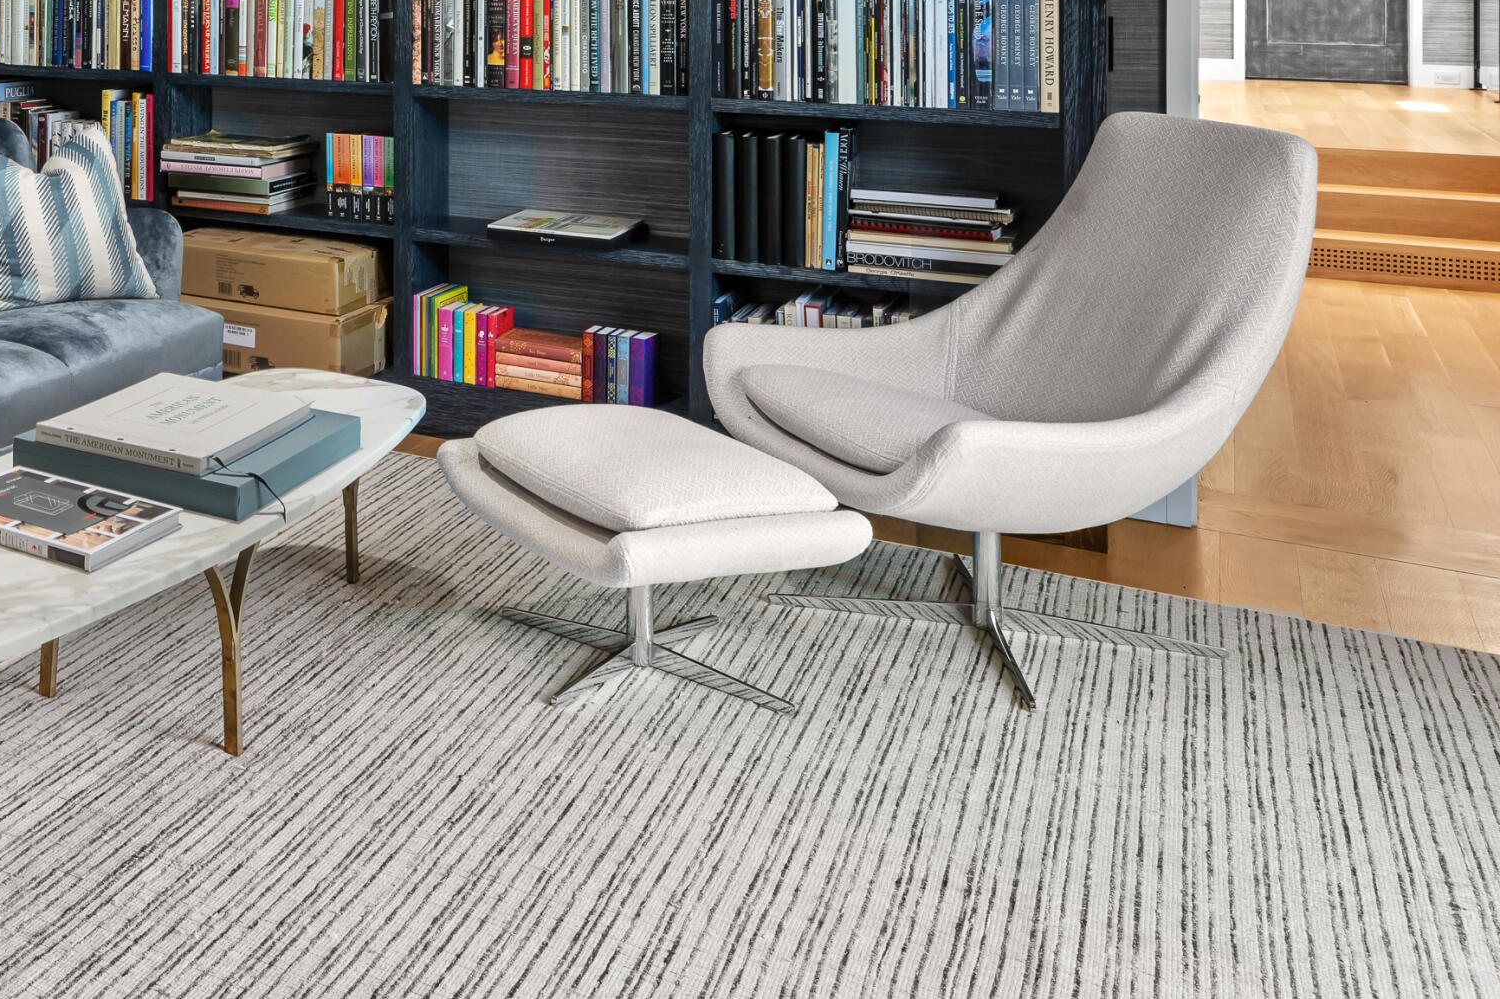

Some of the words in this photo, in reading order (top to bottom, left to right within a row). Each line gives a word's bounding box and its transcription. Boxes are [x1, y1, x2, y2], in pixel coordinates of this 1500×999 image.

[370, 15, 378, 41] PEYTON
[1044, 37, 1054, 86] HOWARD
[5, 86, 36, 98] PUGLIA
[139, 126, 145, 135] IN
[846, 252, 932, 270] BRODOVITCH
[144, 394, 203, 422] AMERICAN
[157, 396, 223, 426] MONUMENT
[64, 433, 83, 445] THE
[81, 436, 125, 456] AMERICAN
[124, 447, 176, 467] MONUMENT
